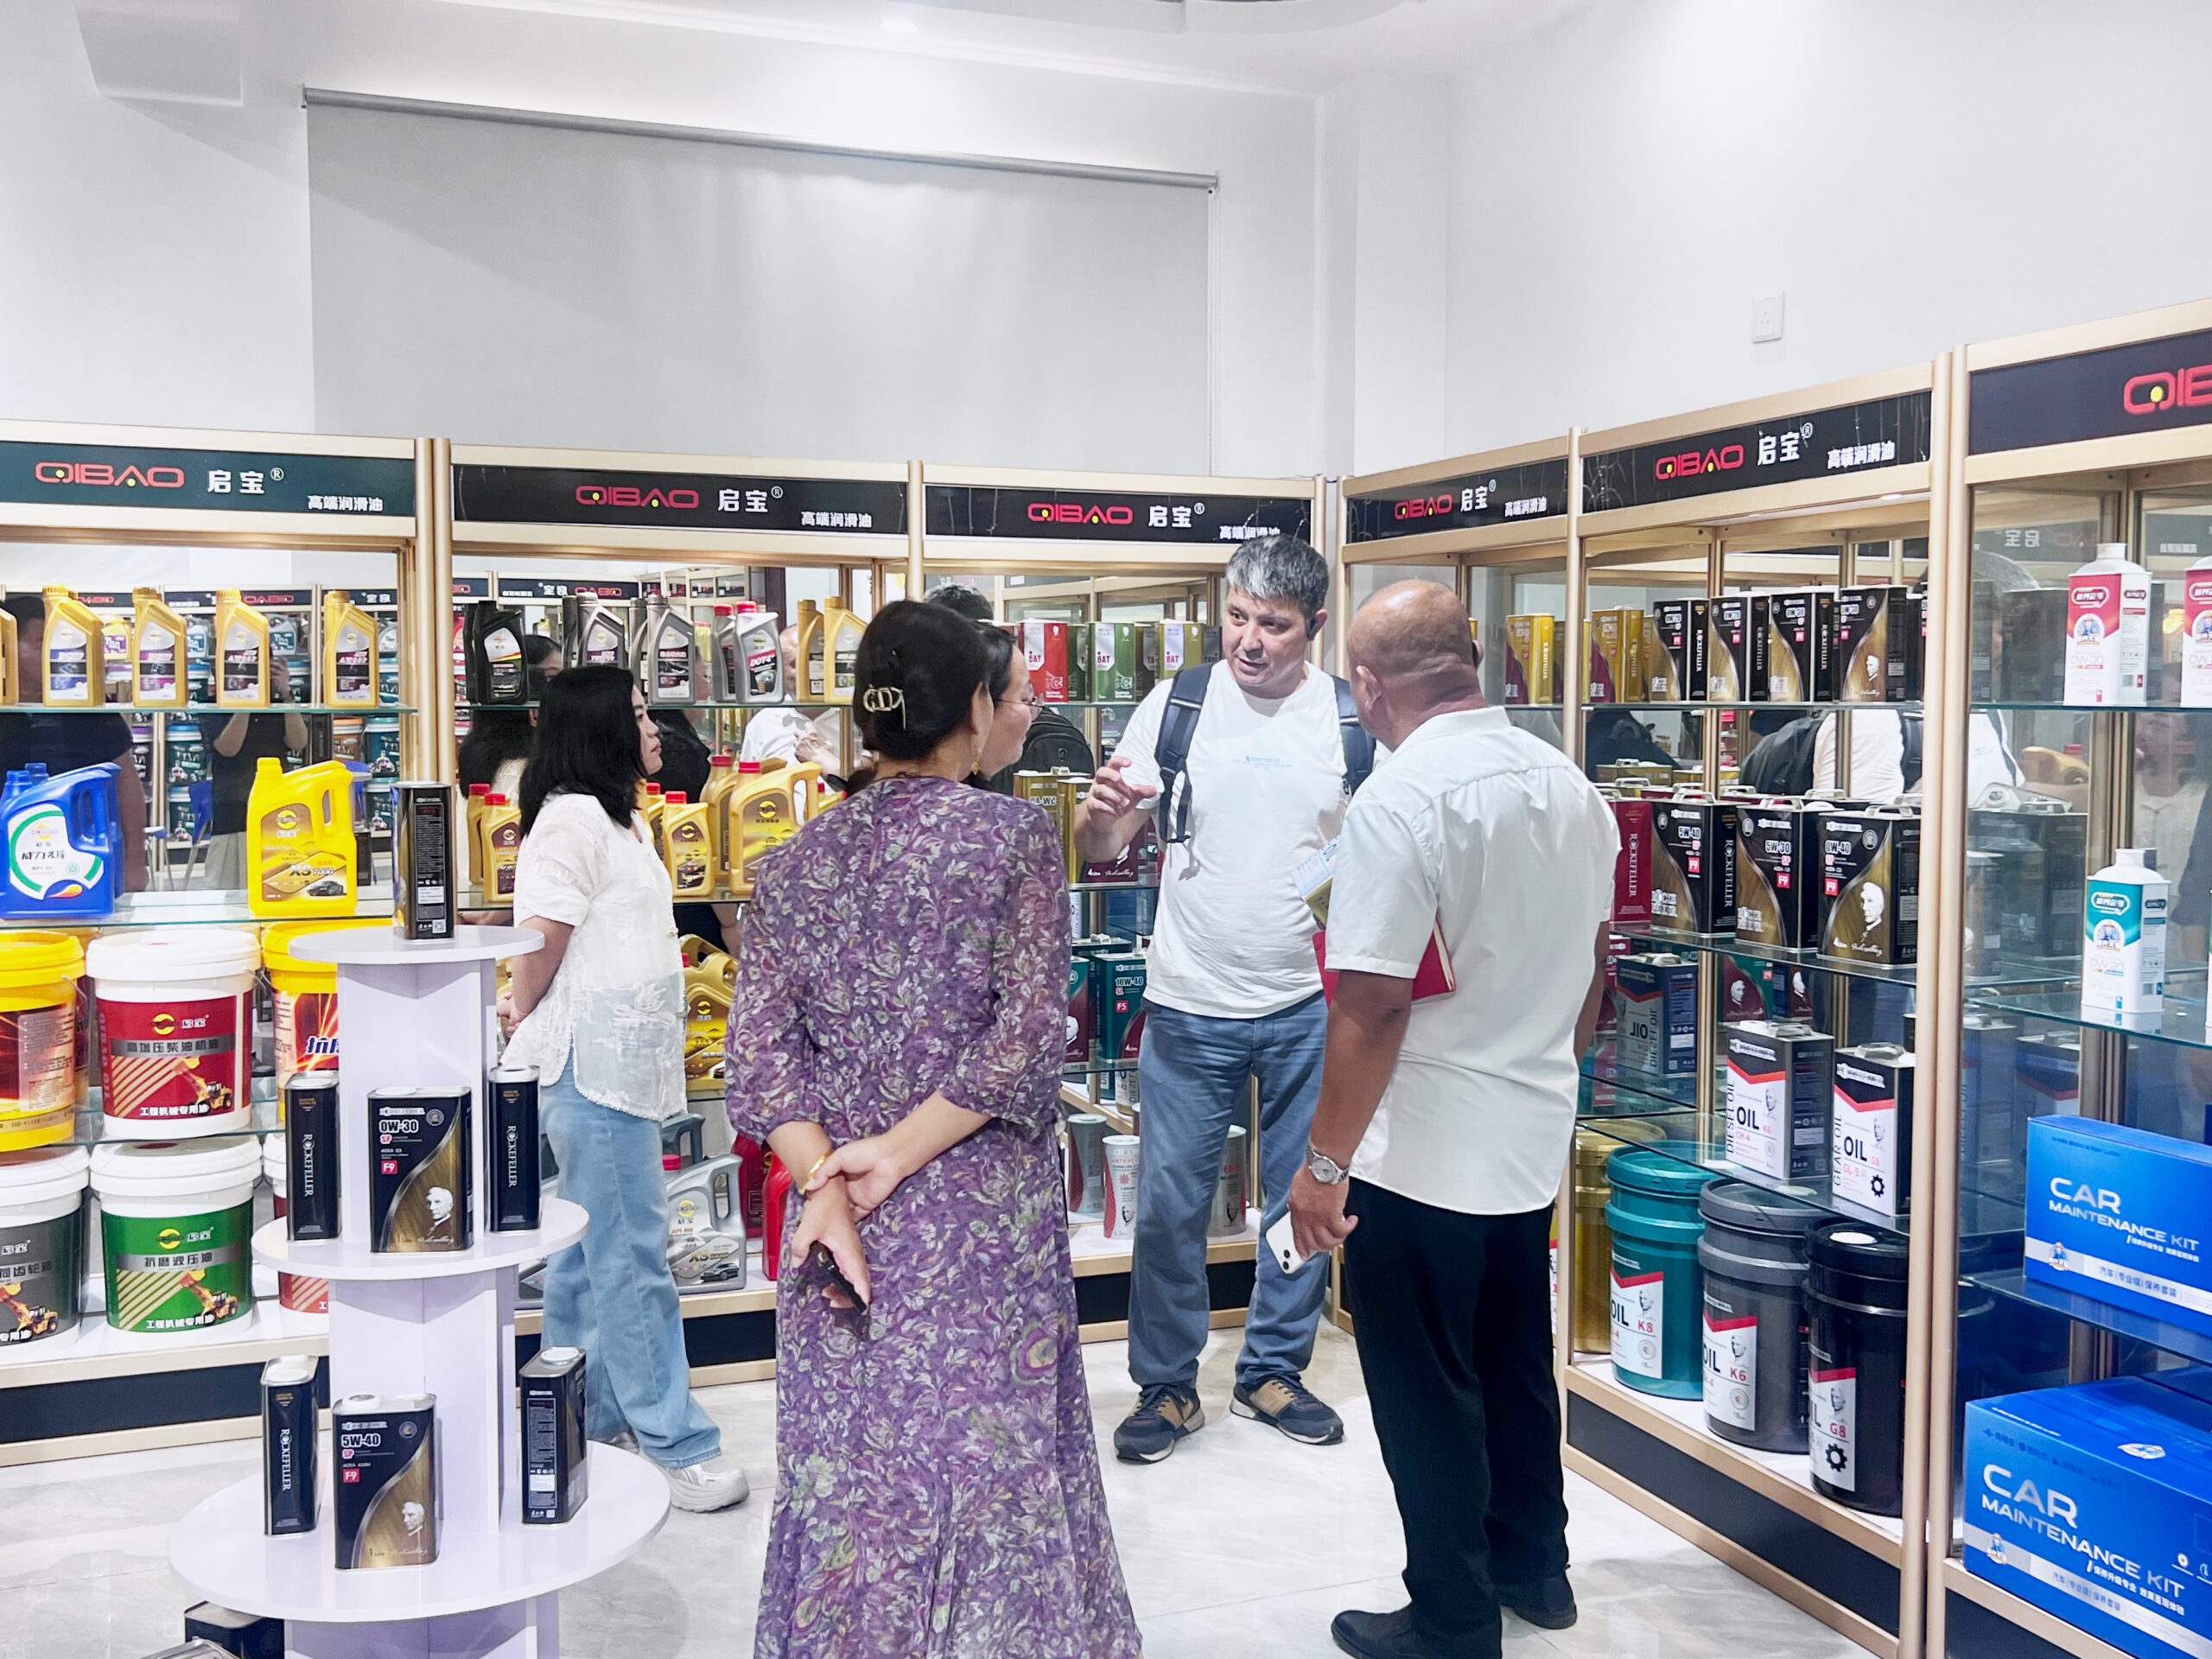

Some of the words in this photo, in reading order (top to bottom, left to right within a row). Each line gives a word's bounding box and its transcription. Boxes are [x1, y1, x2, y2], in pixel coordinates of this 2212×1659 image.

[35, 461, 185, 488] QIBAO
[1656, 444, 1744, 480] QIBAO
[308, 495, 383, 511] 高端润滑油
[575, 485, 699, 509] QIBAO
[1395, 493, 1452, 520] QIBAO
[801, 511, 873, 528] 高端润滑油
[1027, 503, 1133, 524] QIBAO
[1765, 840, 1791, 854] 5W-30
[1825, 840, 1851, 855] 0W-40
[1629, 833, 1638, 898] ROCKEFELLER
[1725, 839, 1734, 907] ROCKEFELLER
[1116, 976, 1144, 986] 10W-40
[379, 1120, 419, 1134] 0W-30
[1737, 1107, 1759, 1130] OIL
[1834, 1114, 1842, 1138] OIL
[506, 1125, 518, 1188] ROCKEFELLER
[1844, 1135, 1867, 1162] OIL
[303, 1134, 315, 1198] ROCKEFELLER
[383, 1162, 395, 1173] F9
[2050, 1177, 2121, 1215] CAR
[2050, 1199, 2166, 1243] MAINTENANCE
[2171, 1234, 2200, 1251] KIT
[1611, 1299, 1630, 1326] OIL
[1638, 1319, 1654, 1333] K8
[1703, 1344, 1721, 1373] OIL
[1730, 1368, 1746, 1381] K6
[341, 1433, 381, 1448] 5W-40
[1830, 1422, 1847, 1438] G8
[280, 1428, 293, 1492] ROCKEFELLER
[345, 1471, 358, 1481] F9
[1983, 1464, 2079, 1529] CAR
[1982, 1494, 2140, 1580] MAINTENANCE
[2147, 1570, 2185, 1599] KIT
